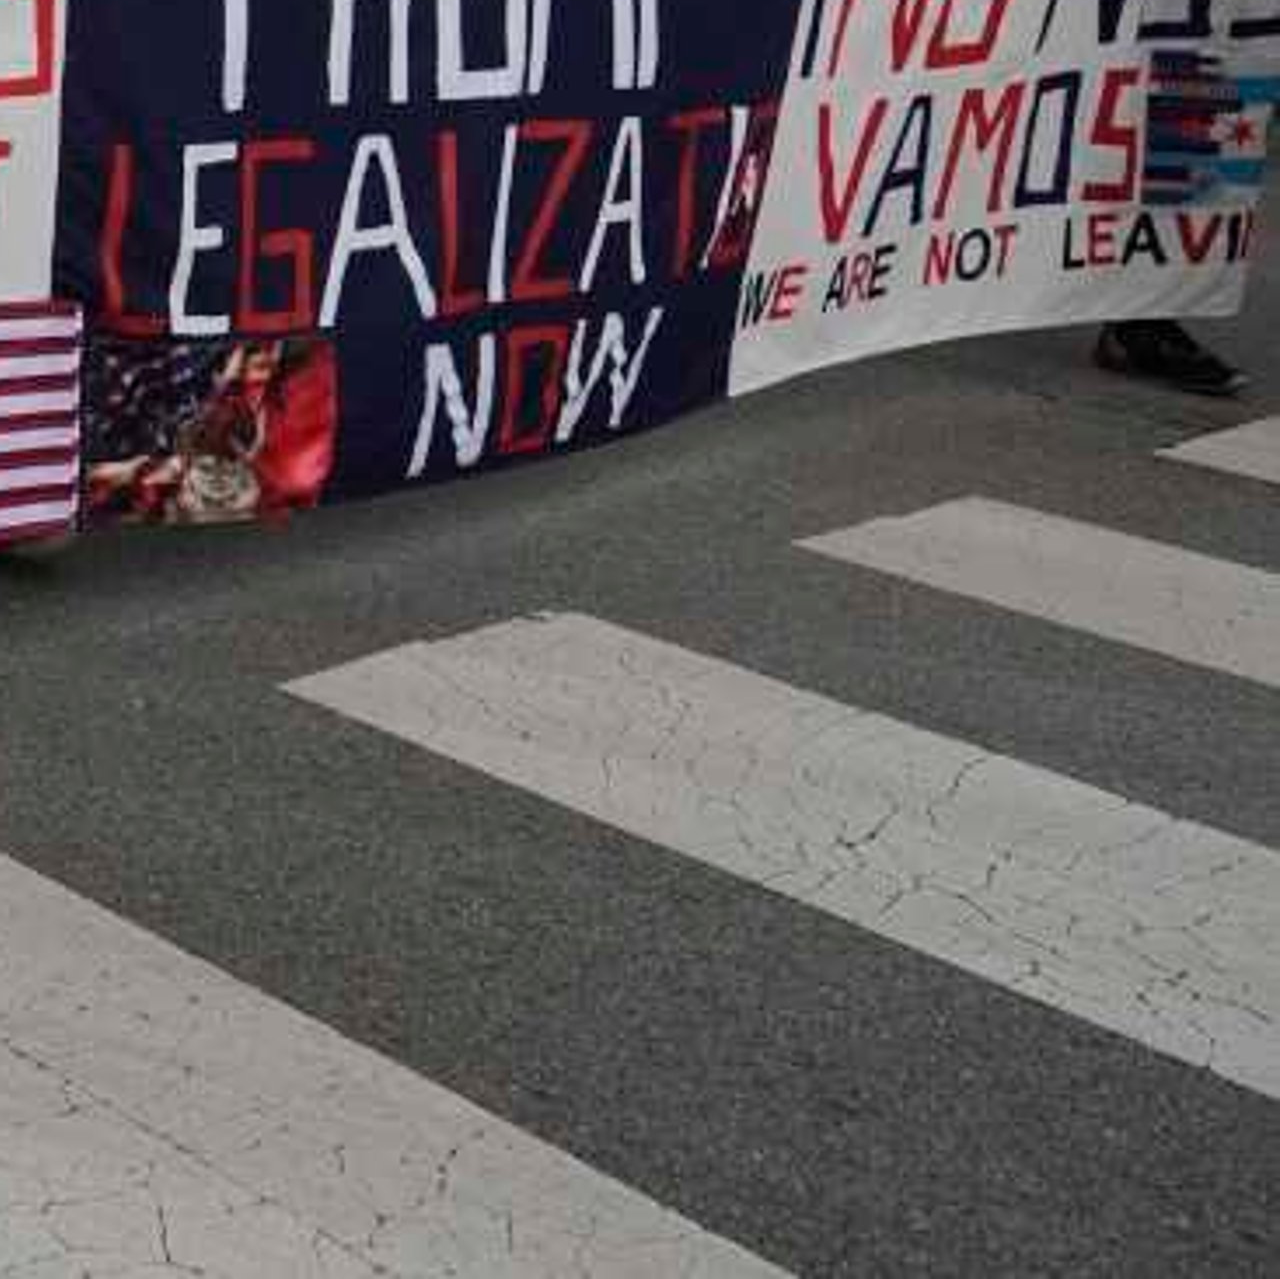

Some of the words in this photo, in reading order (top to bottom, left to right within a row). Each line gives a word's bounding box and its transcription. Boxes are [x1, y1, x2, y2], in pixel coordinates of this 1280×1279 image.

[817, 62, 1145, 245] VAMOS
[742, 263, 809, 330] WE
[822, 243, 898, 313] ARE
[923, 223, 1019, 287] NOT
[1062, 212, 1254, 271] LEAVI
[405, 305, 666, 479] NOW
